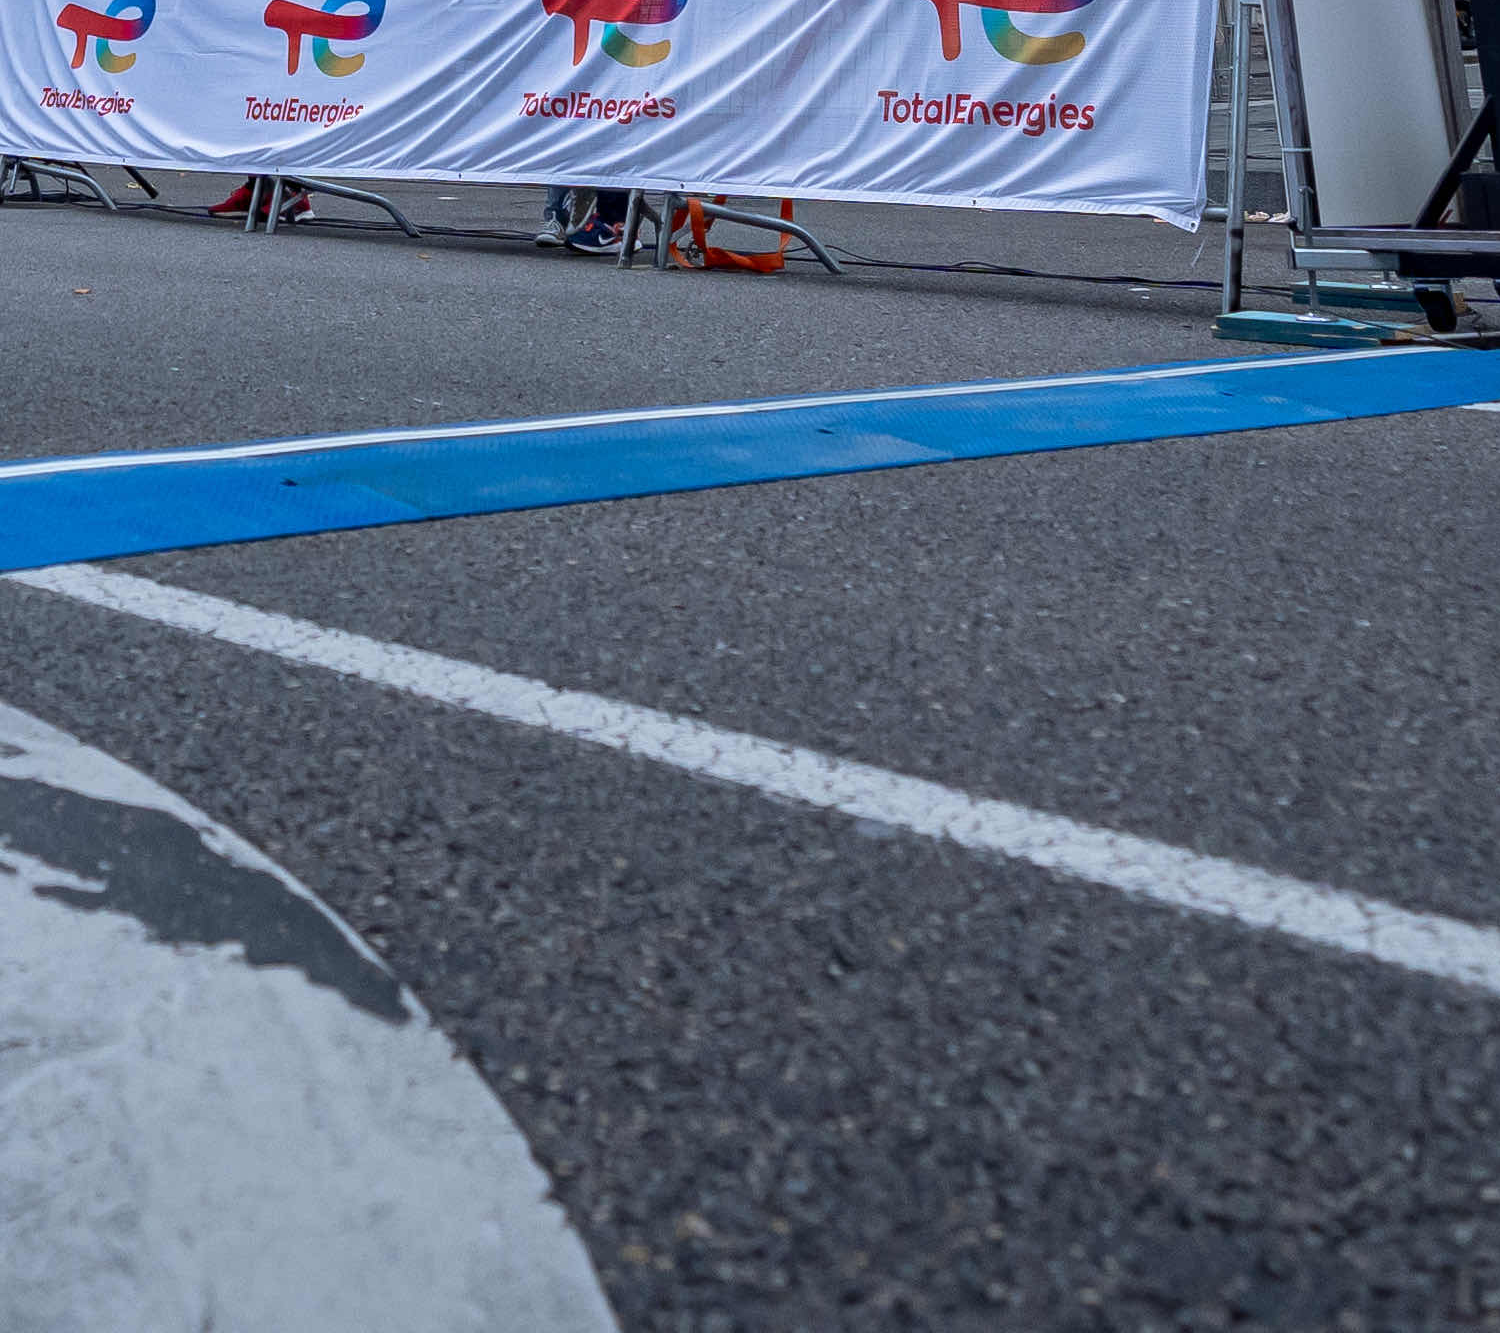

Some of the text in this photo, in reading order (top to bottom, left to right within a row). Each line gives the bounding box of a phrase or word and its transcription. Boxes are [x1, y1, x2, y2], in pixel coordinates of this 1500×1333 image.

[39, 87, 135, 116] TotalEnergies
[245, 96, 364, 129] TotalEnergies
[519, 92, 676, 125] TotalEnergies
[878, 89, 1096, 137] TotalEnergies
